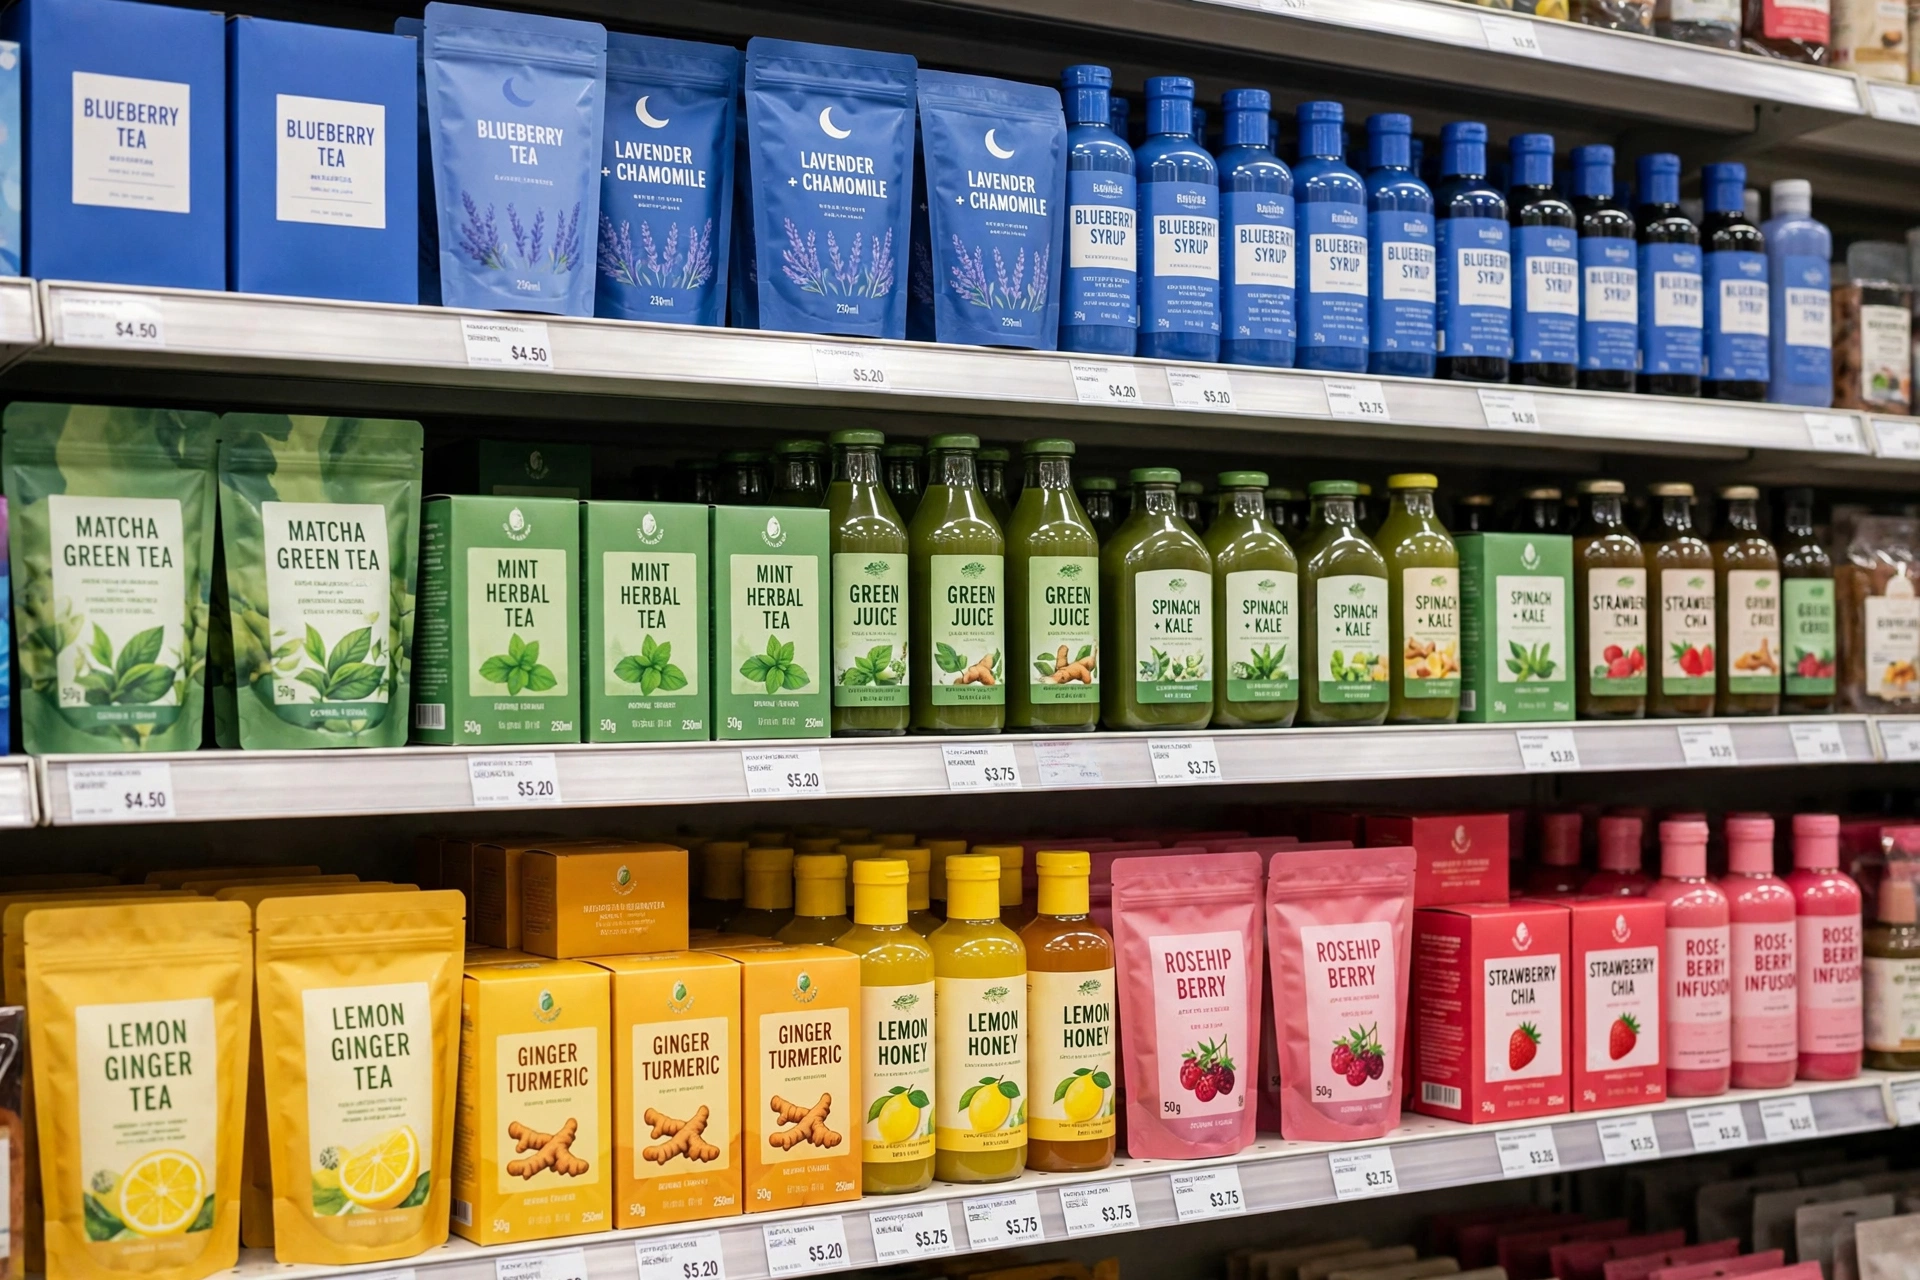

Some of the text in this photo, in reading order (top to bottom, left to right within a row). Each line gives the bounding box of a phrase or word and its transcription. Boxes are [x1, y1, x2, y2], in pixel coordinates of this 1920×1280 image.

[84, 98, 179, 126] BLUEBERRY
[116, 127, 147, 150] TEA
[286, 119, 375, 147] BLUEBERRY
[477, 119, 564, 147] BLUEBERRY
[317, 146, 346, 169] TEA
[510, 145, 538, 165] TEA
[615, 140, 692, 165] LAVENDER
[801, 151, 874, 175] LAVENDER
[601, 162, 706, 189] + CHAMOMILE
[968, 170, 1035, 194] LAVENDER
[788, 173, 888, 199] + CHAMOMILE
[955, 192, 1047, 217] + CHAMOMILE
[1090, 229, 1126, 246] SYRUP
[1174, 238, 1209, 255] SYRUP
[1255, 247, 1287, 264] SYRUP
[1330, 257, 1360, 273] SYRUP
[1402, 265, 1430, 280] SYRUP
[1477, 271, 1504, 285] SYRUP
[115, 321, 157, 341] $4.50
[511, 345, 547, 362] $4.50
[853, 368, 884, 383] $5.20
[76, 516, 159, 540] MATCHA
[288, 520, 366, 543] MATCHA
[63, 544, 173, 568] GREEN TEA
[277, 547, 380, 571] GREEN TEA
[497, 559, 538, 579] MINT
[631, 562, 670, 582] MINT
[756, 565, 793, 584] MINT
[486, 583, 550, 603] HERBAL
[620, 586, 681, 606] HERBAL
[746, 588, 804, 607] HERBAL
[850, 584, 899, 604] GREEN
[948, 585, 995, 604] GREEN
[1045, 586, 1091, 604] GREEN
[1511, 591, 1552, 606] SPINACH
[1152, 599, 1200, 615] SPINACH
[1243, 600, 1288, 615] SPINACH
[1334, 604, 1378, 619] SPINACH
[1416, 596, 1457, 611] SPINACH
[504, 608, 534, 628] TEA
[638, 610, 667, 629] TEA
[763, 610, 790, 630] TEA
[853, 607, 897, 626] JUICE
[951, 607, 994, 626] JUICE
[1049, 607, 1090, 626] JUICE
[1154, 618, 1193, 633] + KALE
[1245, 618, 1282, 633] + KALE
[1428, 614, 1453, 628] KALE
[1521, 609, 1545, 622] KALE
[1335, 622, 1371, 636] + KALE
[464, 719, 482, 735] 50g
[551, 720, 573, 733] 250ml
[600, 718, 703, 733] 50g 250ml
[726, 716, 824, 731] 50g 250ml
[984, 766, 1015, 782] $3.75
[1187, 760, 1216, 775] $3.75
[517, 779, 554, 798] $5.20
[787, 773, 819, 789] $5.20
[125, 791, 166, 809] $4.50
[1316, 938, 1381, 962] ROSEHIP
[1164, 948, 1232, 973] ROSEHIP
[1589, 957, 1655, 978] STRAWBERRY
[1687, 959, 1725, 977] BERRY
[1755, 953, 1791, 972] BERRY
[1328, 965, 1376, 989] BERRY
[1489, 965, 1556, 986] STRAWBERRY
[1177, 975, 1226, 1000] BERRY
[1511, 988, 1535, 1005] CHIA
[1611, 979, 1634, 996] CHIA
[332, 1003, 405, 1030] LEMON
[968, 1010, 1019, 1032] LEMON
[1064, 1003, 1110, 1025] LEMON
[108, 1019, 187, 1048] LEMON
[778, 1022, 832, 1045] GINGER
[878, 1018, 928, 1041] LEMON
[1064, 1026, 1109, 1048] HONEY
[331, 1032, 410, 1061] GINGER
[653, 1032, 710, 1055] GINGER
[968, 1033, 1018, 1056] HONEY
[518, 1042, 577, 1067] GINGER
[768, 1044, 842, 1070] TURMERIC
[878, 1042, 927, 1066] HONEY
[105, 1051, 192, 1081] GINGER
[642, 1055, 720, 1081] TURMERIC
[354, 1065, 392, 1091] TEA
[507, 1066, 589, 1093] TURMERIC
[129, 1085, 172, 1112] TEA
[1315, 1085, 1332, 1098] 50g
[1164, 1101, 1181, 1115] 50g
[1366, 1170, 1393, 1187] $3.75
[756, 1180, 855, 1201] 50g 250ml
[1210, 1190, 1239, 1208] $3.75
[630, 1195, 735, 1217] 50g 250ml
[1102, 1204, 1132, 1222] $3.75
[493, 1210, 604, 1233] 50g 250ml
[1006, 1216, 1038, 1236] $5.75
[915, 1229, 948, 1248] $5.75
[809, 1242, 843, 1263] $5.20
[683, 1260, 718, 1280] $5.20
